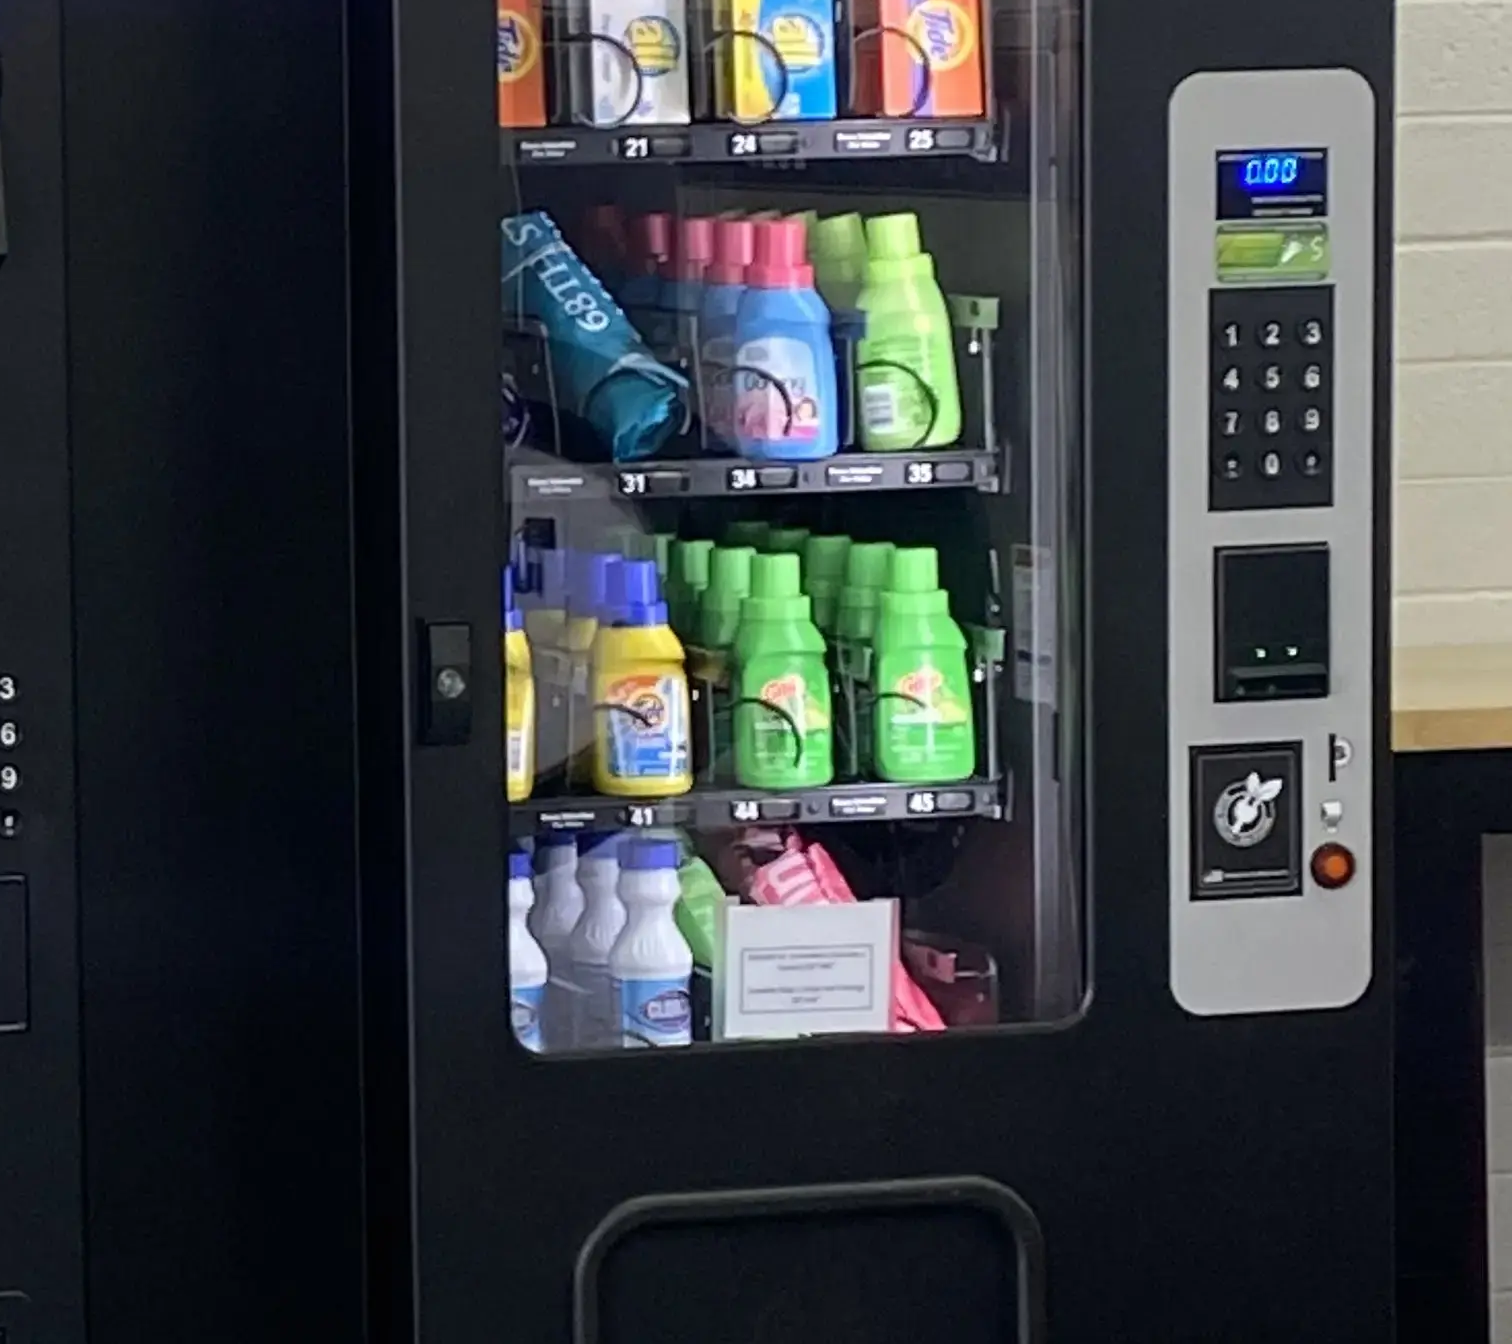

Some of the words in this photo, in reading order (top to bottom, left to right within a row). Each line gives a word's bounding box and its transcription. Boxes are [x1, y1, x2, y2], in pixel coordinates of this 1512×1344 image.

[918, 8, 954, 62] Tide
[625, 137, 648, 157] 21
[732, 134, 757, 154] 24
[909, 129, 934, 150] 25
[1226, 325, 1238, 347] 1
[1265, 324, 1280, 345] 2
[1305, 322, 1321, 345] 3
[1223, 368, 1239, 389] 4
[1266, 366, 1280, 389] 5
[1305, 366, 1320, 388] 6
[1226, 412, 1238, 434] 7
[1265, 411, 1280, 433] 8
[1305, 409, 1320, 430] 9
[908, 463, 933, 484] 35
[1265, 453, 1279, 475] 0
[623, 473, 646, 494] 31
[0, 722, 16, 746] 6
[1, 766, 18, 790] 9
[909, 793, 934, 813] 45
[630, 806, 654, 827] 41
